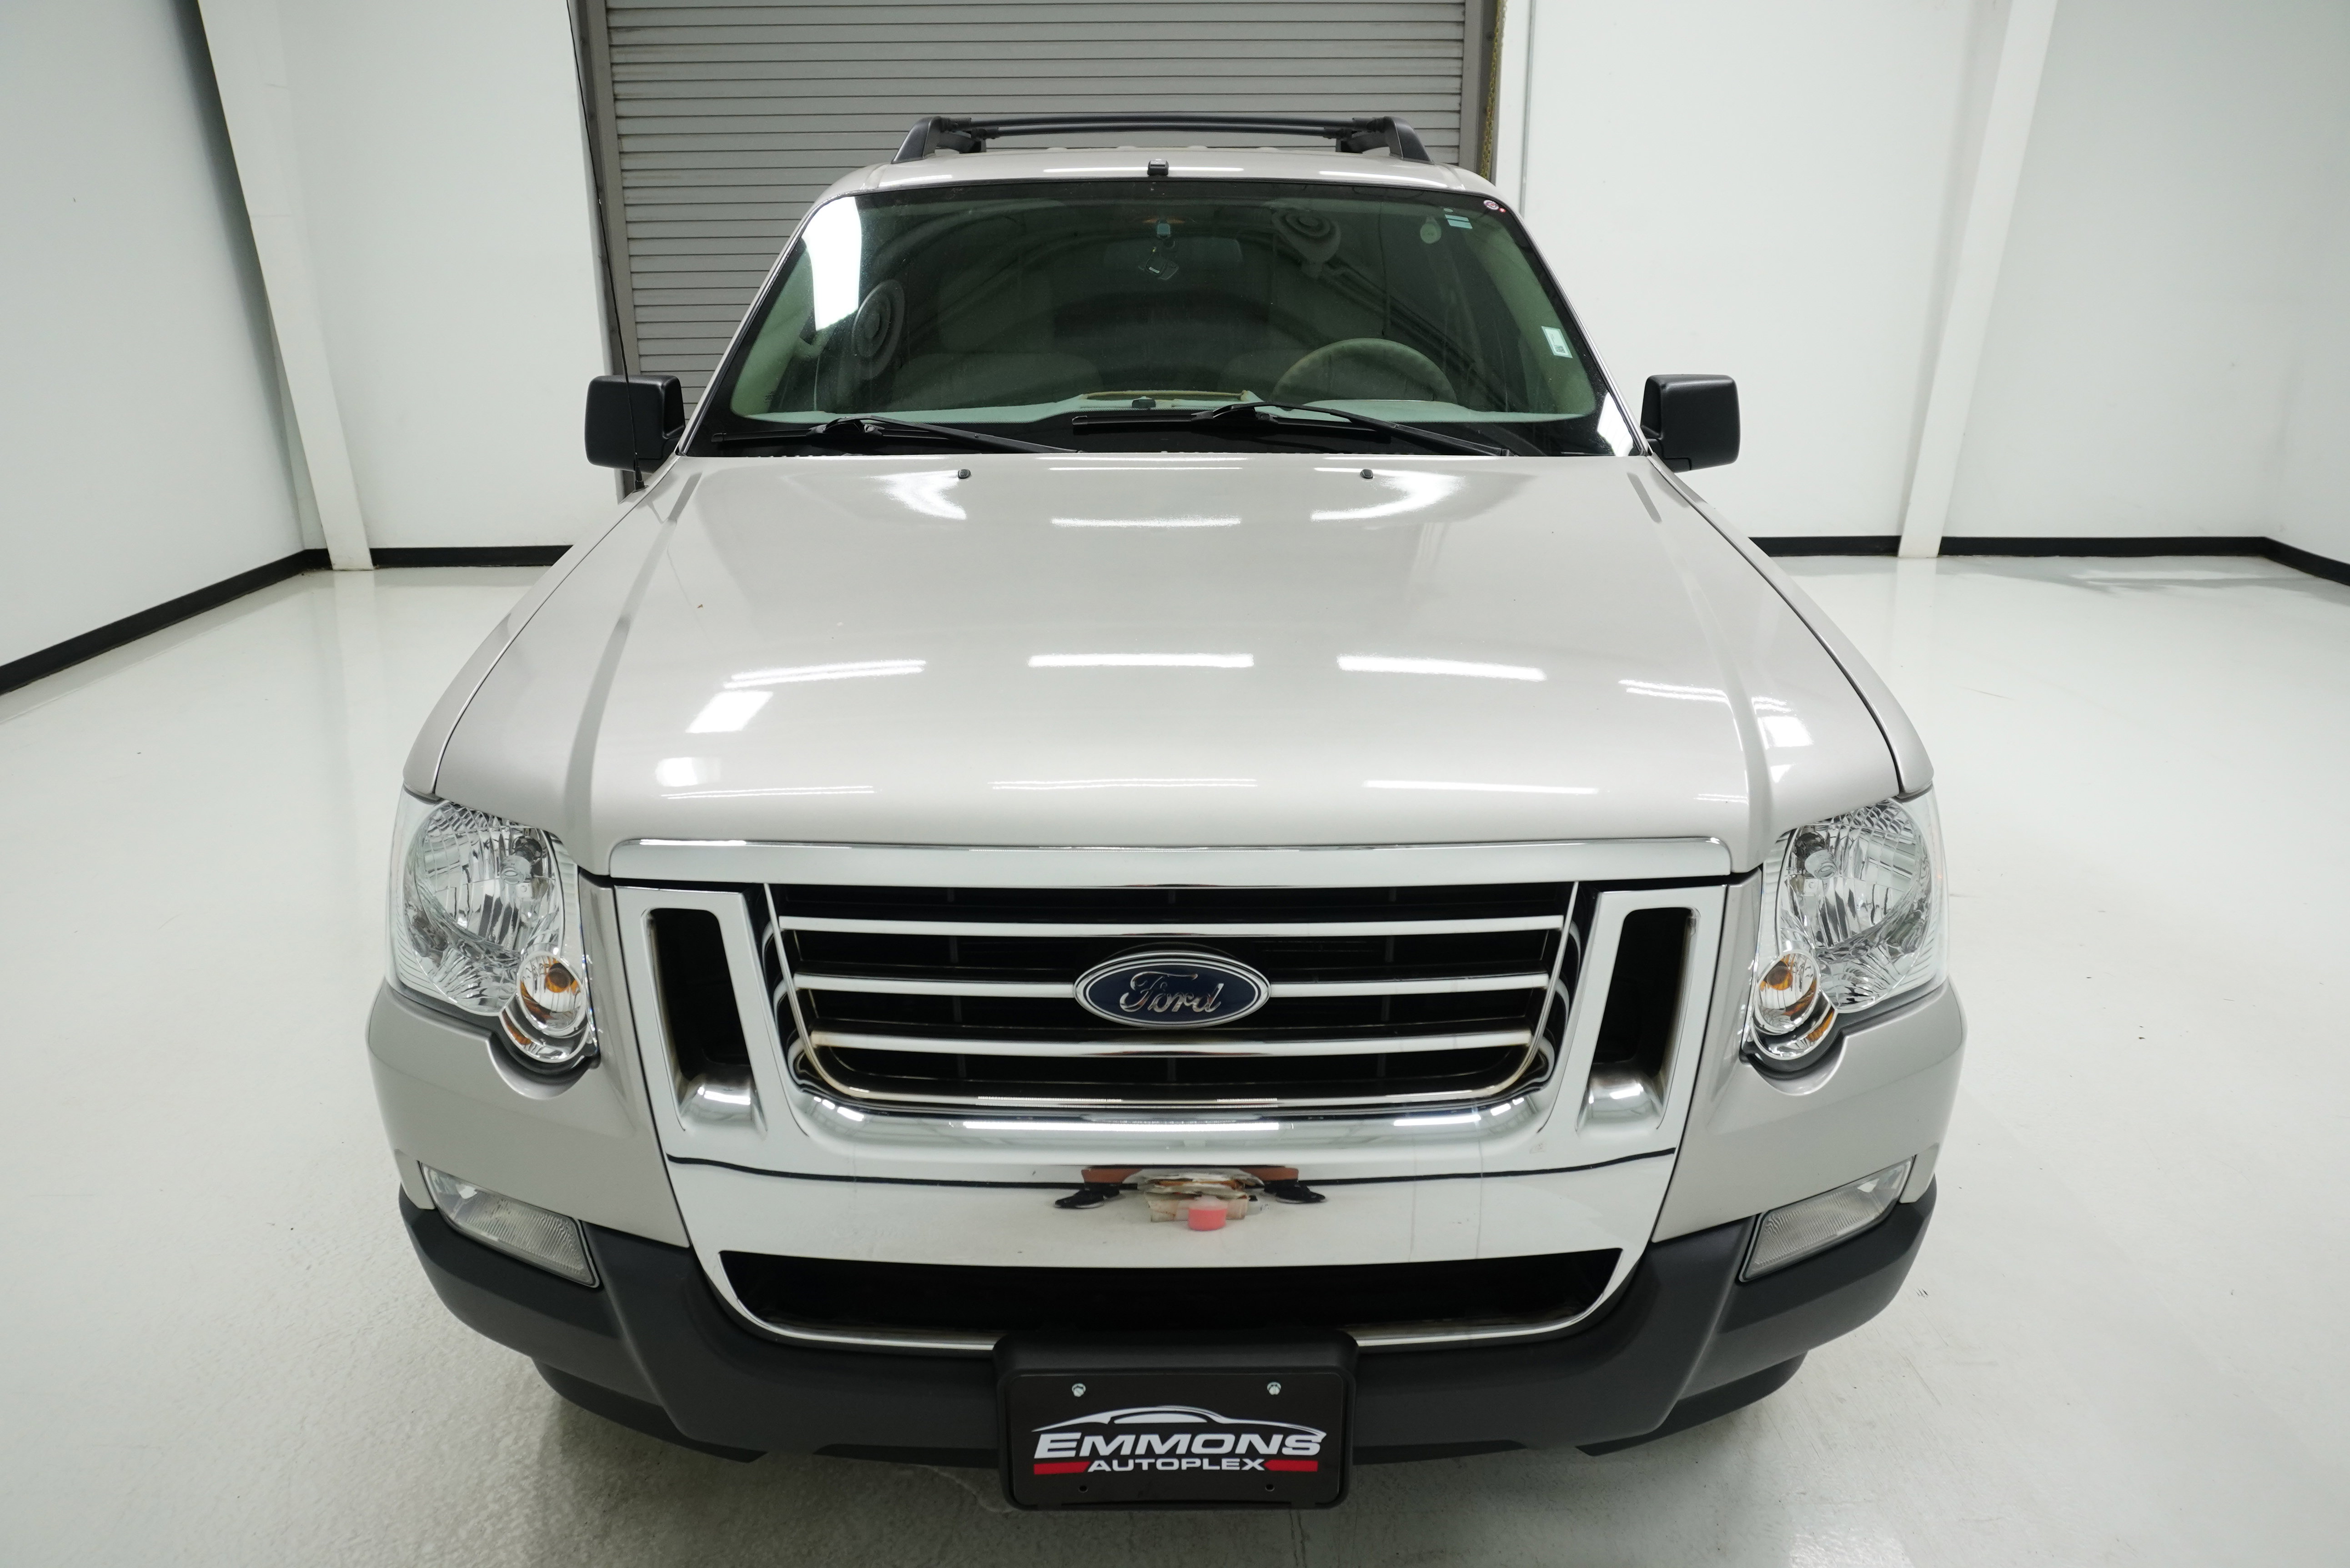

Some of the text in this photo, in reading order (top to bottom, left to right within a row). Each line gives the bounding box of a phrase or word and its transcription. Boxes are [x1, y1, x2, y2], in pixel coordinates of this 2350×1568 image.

[1120, 971, 1224, 1012] Ford
[1034, 1432, 1320, 1459] EMMONS
[1087, 1458, 1265, 1473] AUTOPLEX
